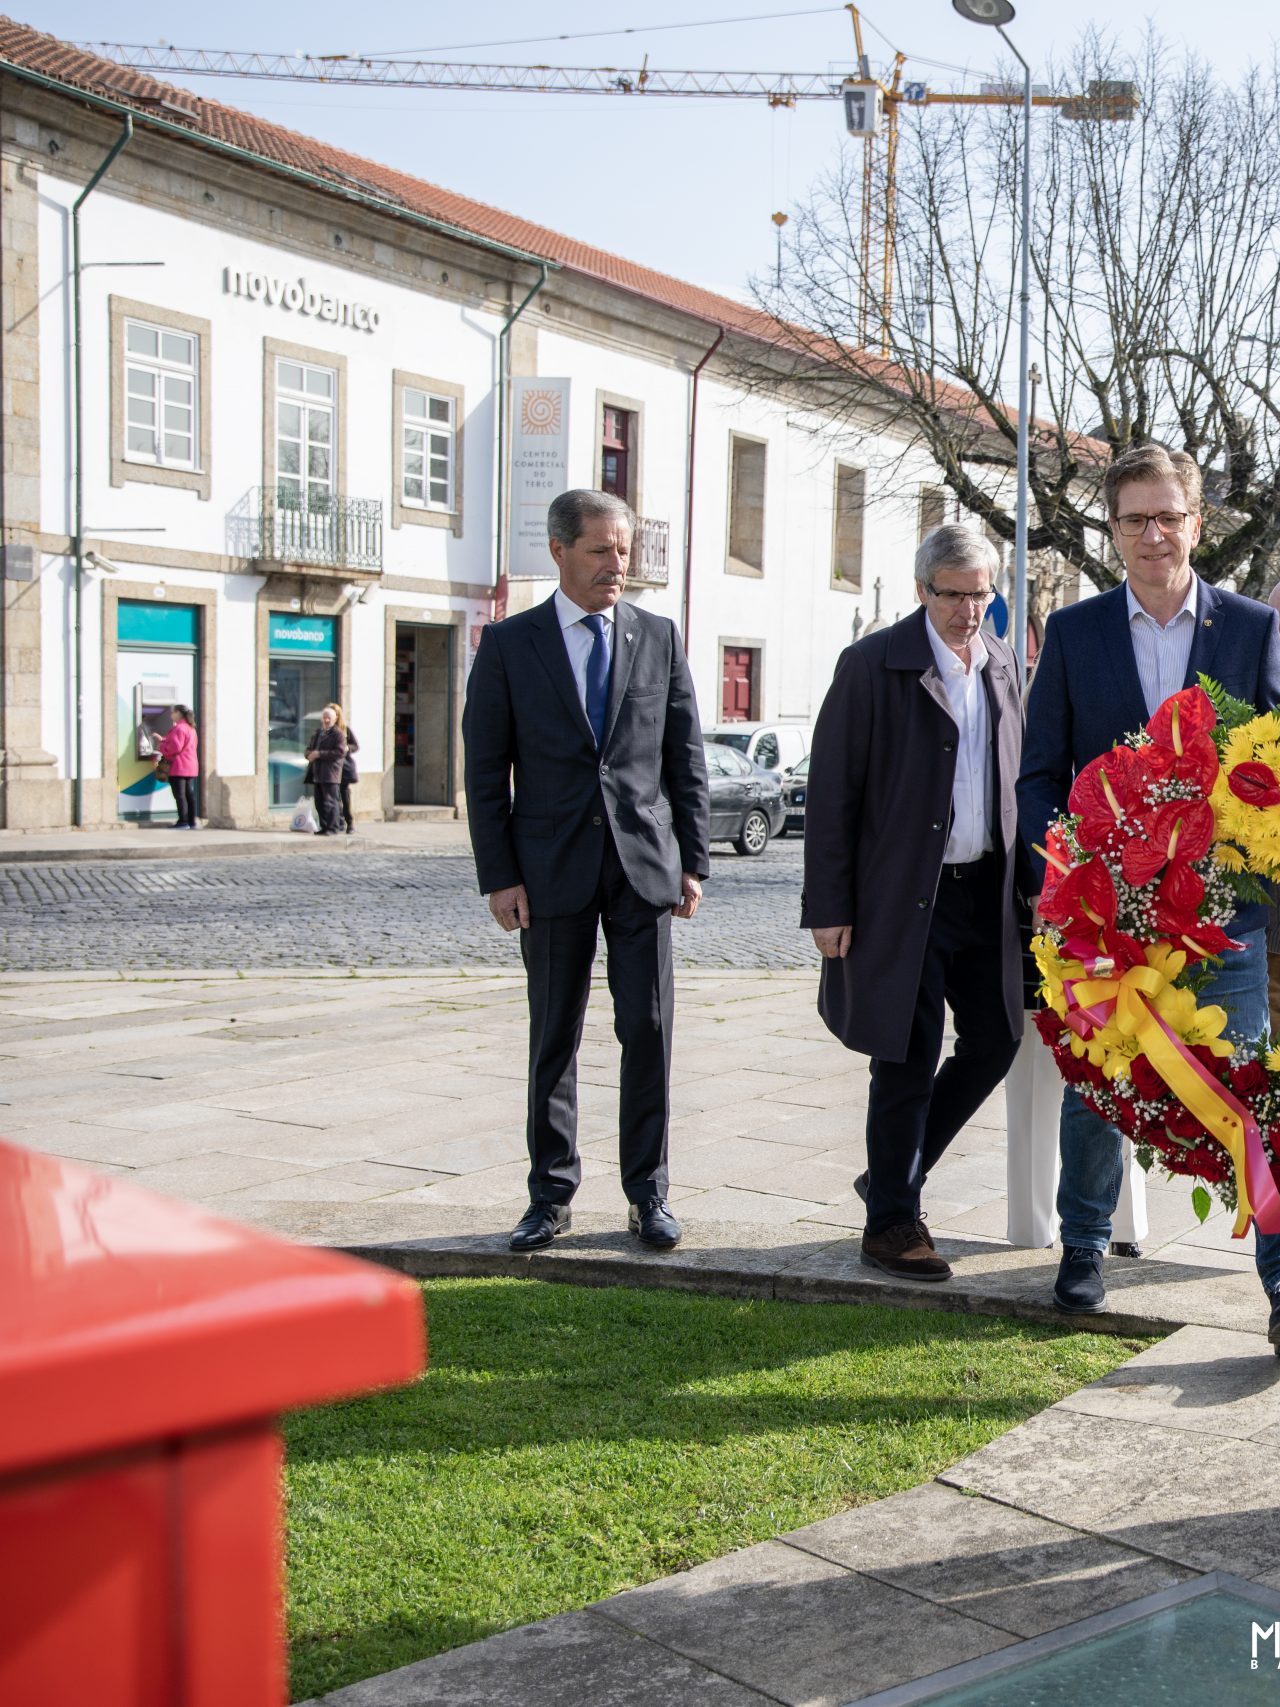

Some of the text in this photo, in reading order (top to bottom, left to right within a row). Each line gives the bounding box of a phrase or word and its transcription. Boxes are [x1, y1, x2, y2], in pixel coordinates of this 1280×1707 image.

[222, 265, 380, 334] novobanco
[523, 450, 558, 458] CENTRO
[514, 460, 566, 468] COMERCIAL
[274, 628, 324, 642] novobanco
